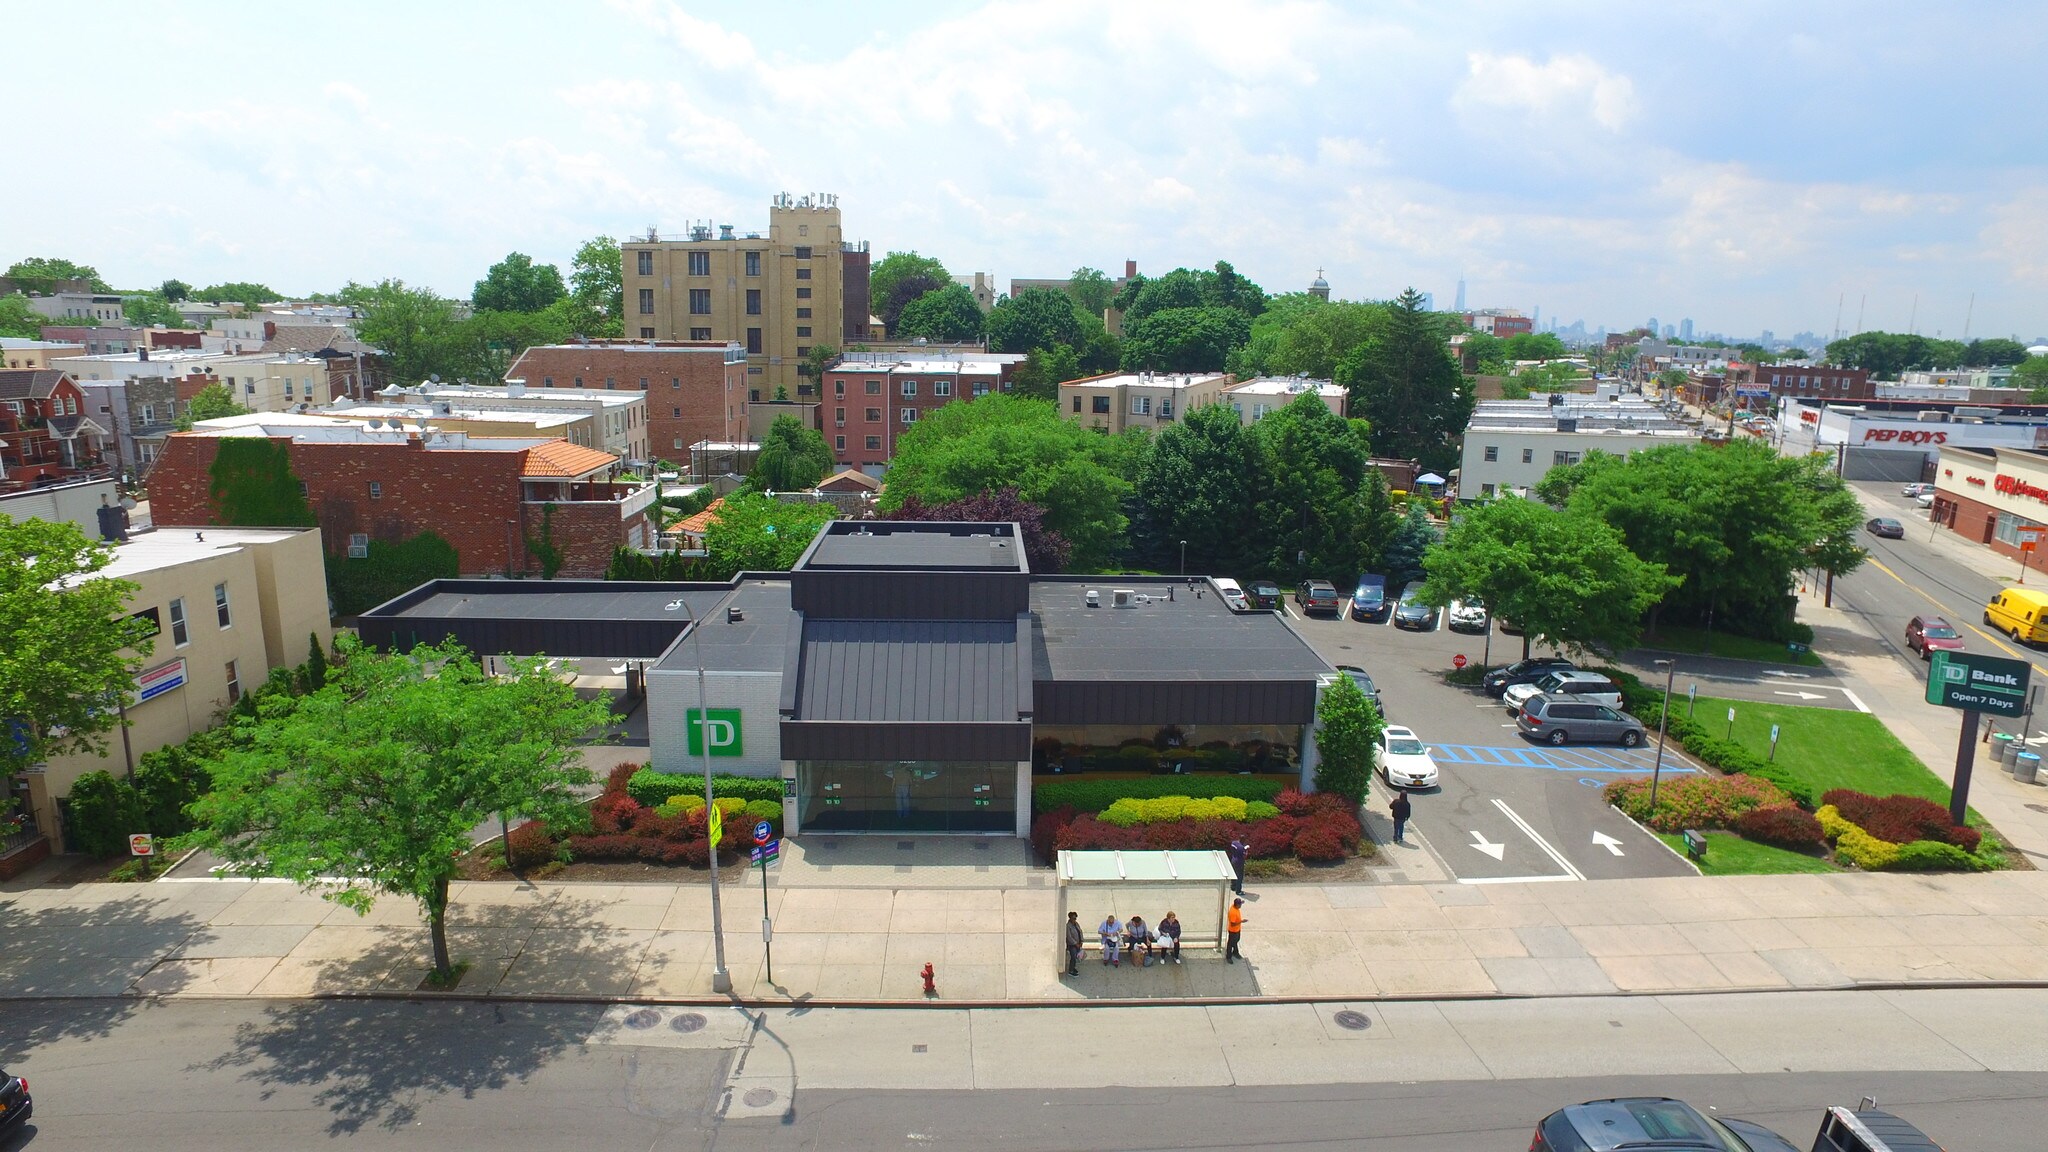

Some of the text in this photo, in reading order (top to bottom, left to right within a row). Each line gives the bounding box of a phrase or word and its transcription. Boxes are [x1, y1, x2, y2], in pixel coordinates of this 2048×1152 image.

[1864, 429, 1948, 445] PEP BOYS
[1942, 665, 2018, 686] TD Bank
[1951, 691, 2014, 709] Open 7 Days
